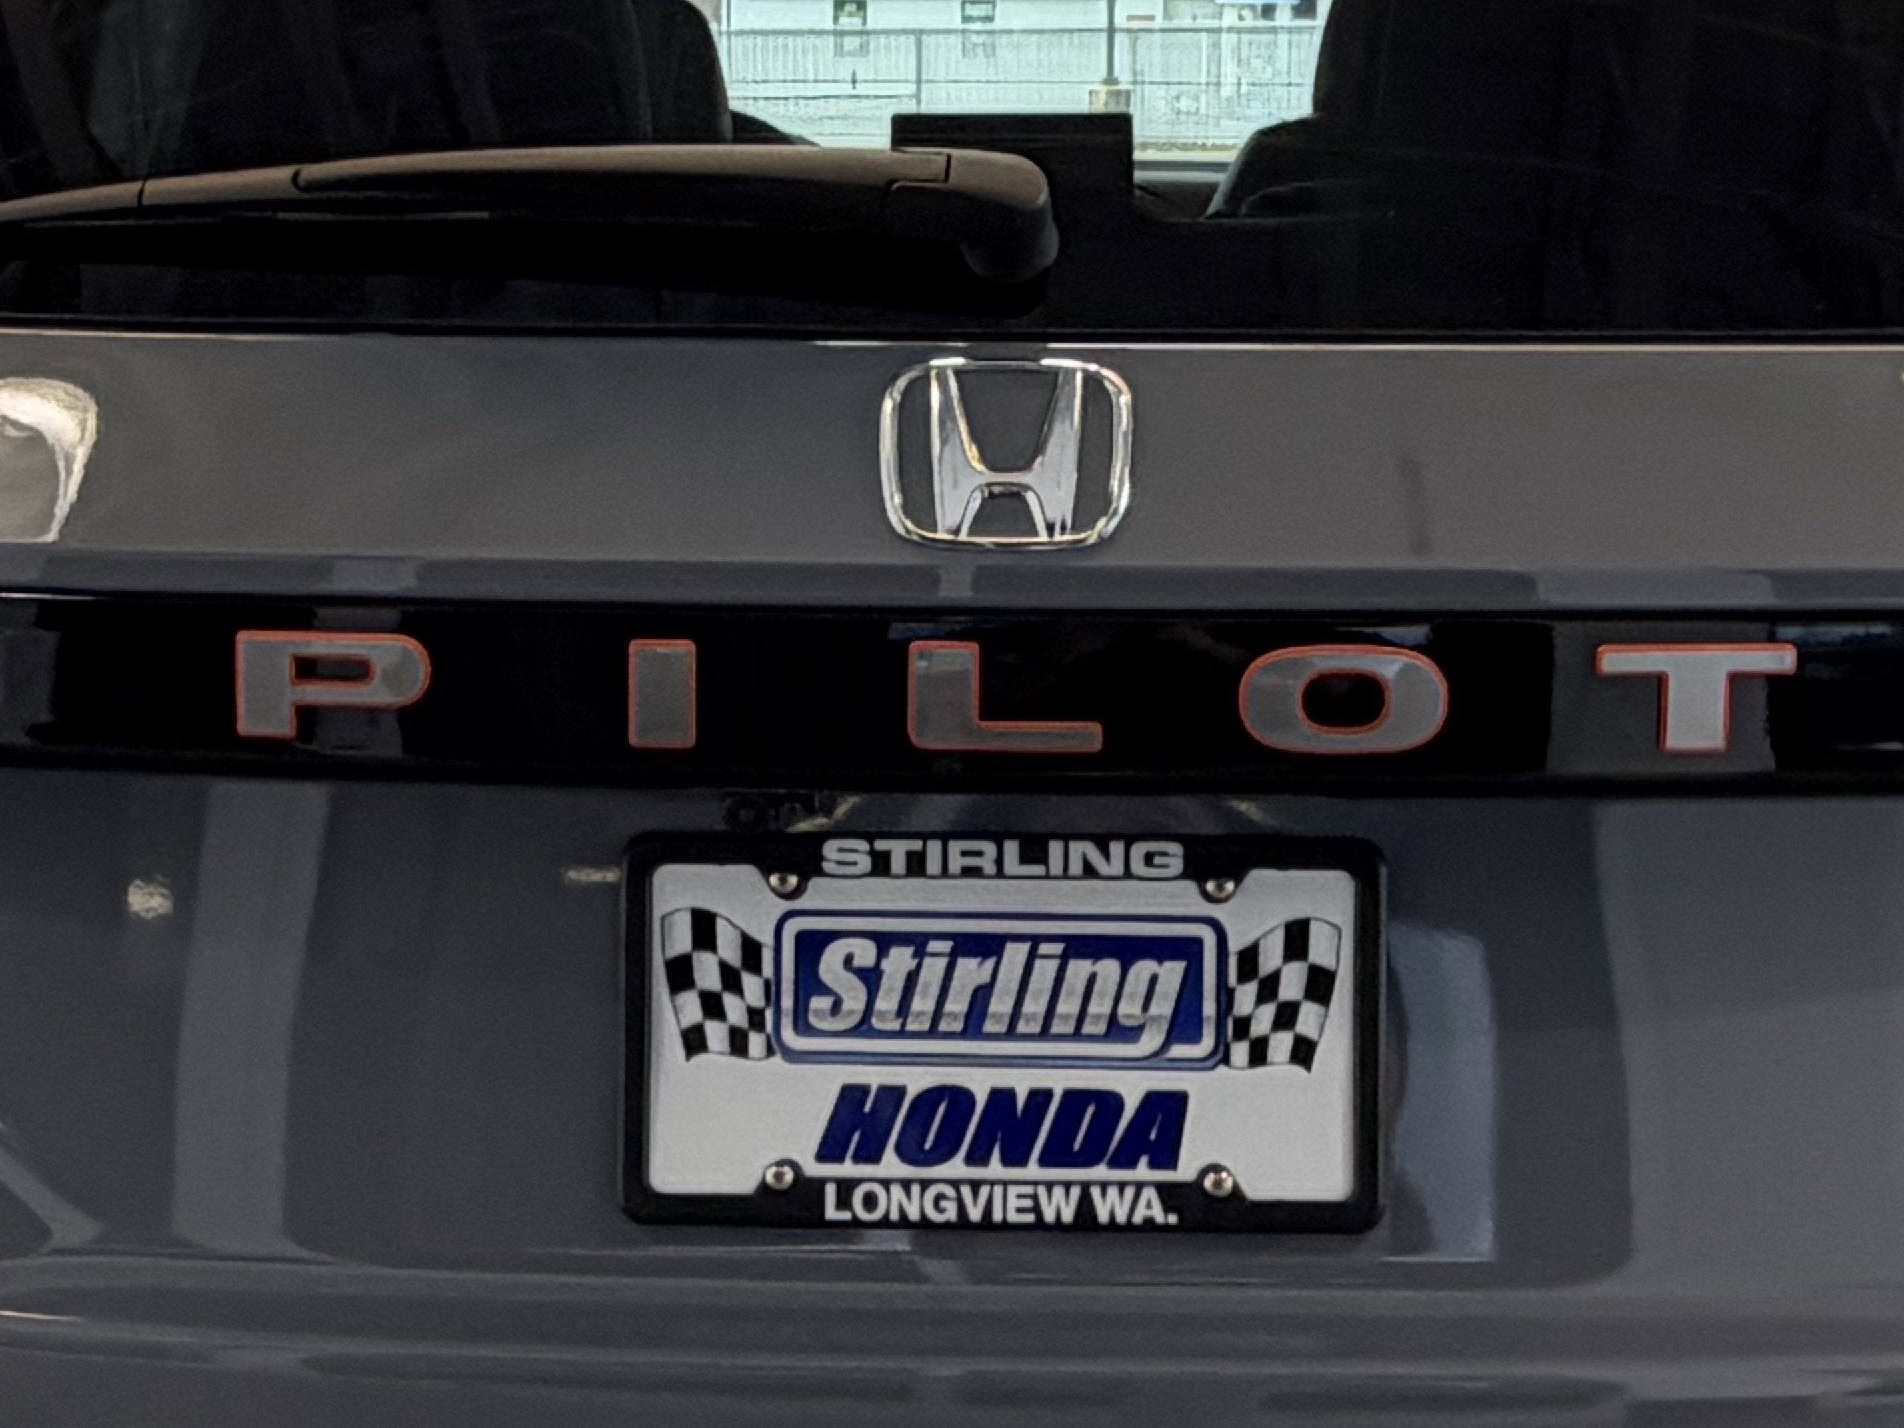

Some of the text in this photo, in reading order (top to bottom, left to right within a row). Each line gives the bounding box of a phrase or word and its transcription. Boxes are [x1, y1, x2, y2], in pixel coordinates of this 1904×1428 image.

[236, 630, 1798, 755] PILOT
[821, 839, 1185, 877] STIRLING
[808, 936, 1188, 1059] Stirling
[814, 1083, 1190, 1171] HONDA
[824, 1182, 1179, 1226] LONGVIEW WA.
